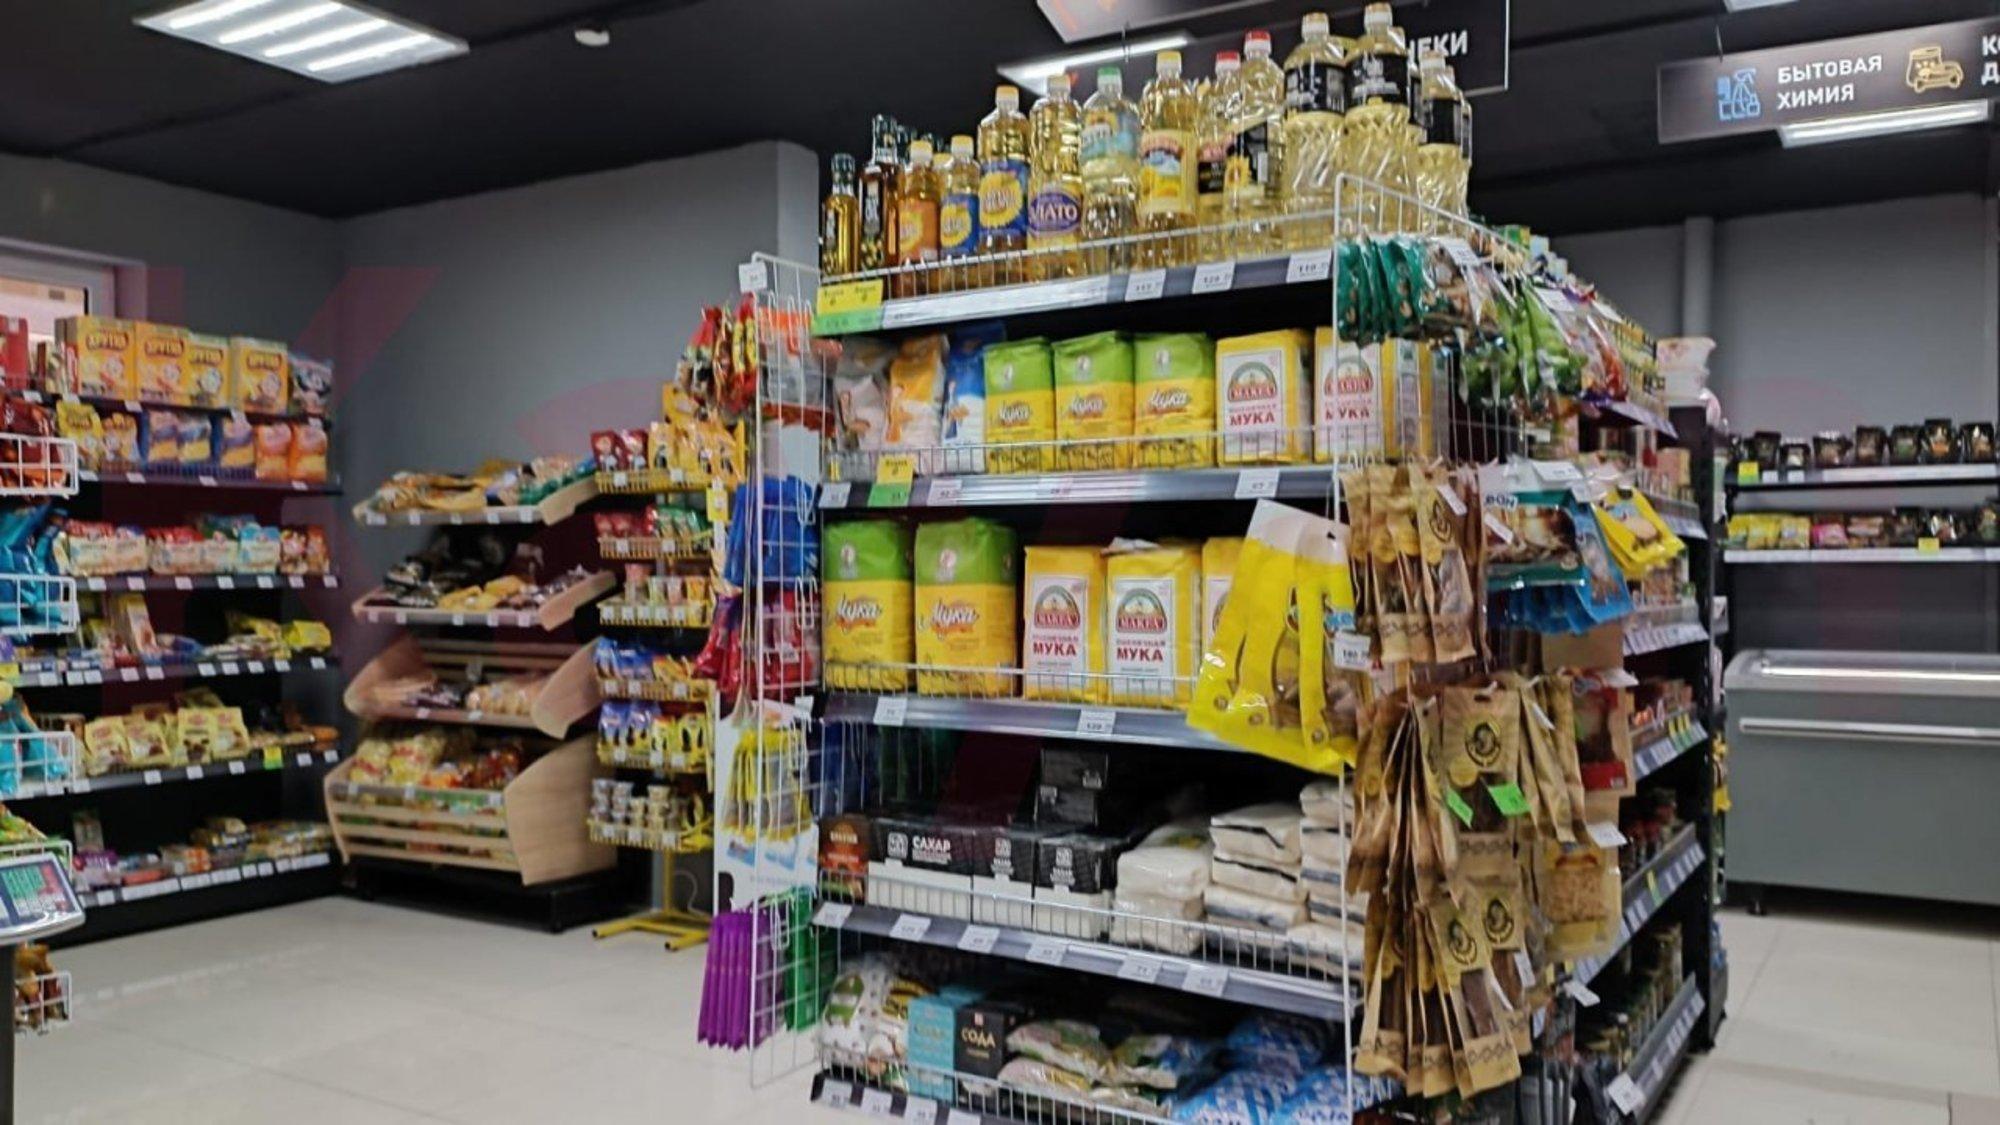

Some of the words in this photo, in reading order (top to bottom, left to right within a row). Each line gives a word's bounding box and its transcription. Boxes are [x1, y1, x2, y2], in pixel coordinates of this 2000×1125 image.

[1983, 34, 2000, 56] К
[1777, 55, 1883, 85] БЫТОВАЯ
[1777, 83, 1854, 110] ХИМИЯ
[1230, 411, 1275, 427] МУКА
[1033, 642, 1077, 656] МУКА
[1117, 647, 1163, 661] МУКА
[912, 835, 951, 852] САХАР
